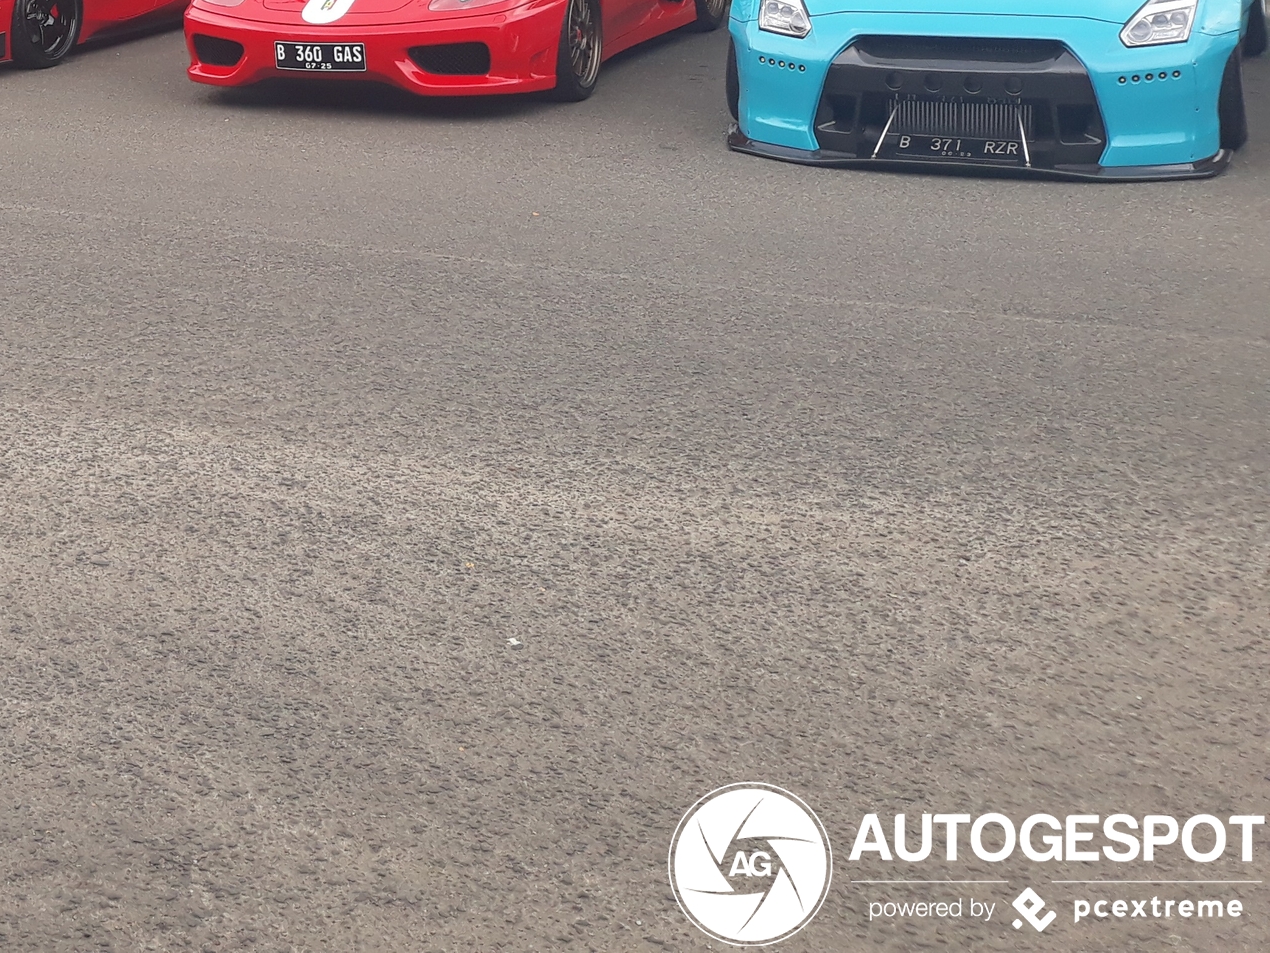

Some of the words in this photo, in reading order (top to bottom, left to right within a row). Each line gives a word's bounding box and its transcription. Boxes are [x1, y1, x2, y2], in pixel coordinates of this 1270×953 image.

[277, 44, 286, 60] B
[295, 45, 323, 62] 360
[333, 46, 362, 63] GAS
[899, 135, 912, 149] B
[930, 137, 962, 152] 371
[984, 141, 1019, 156] RZR
